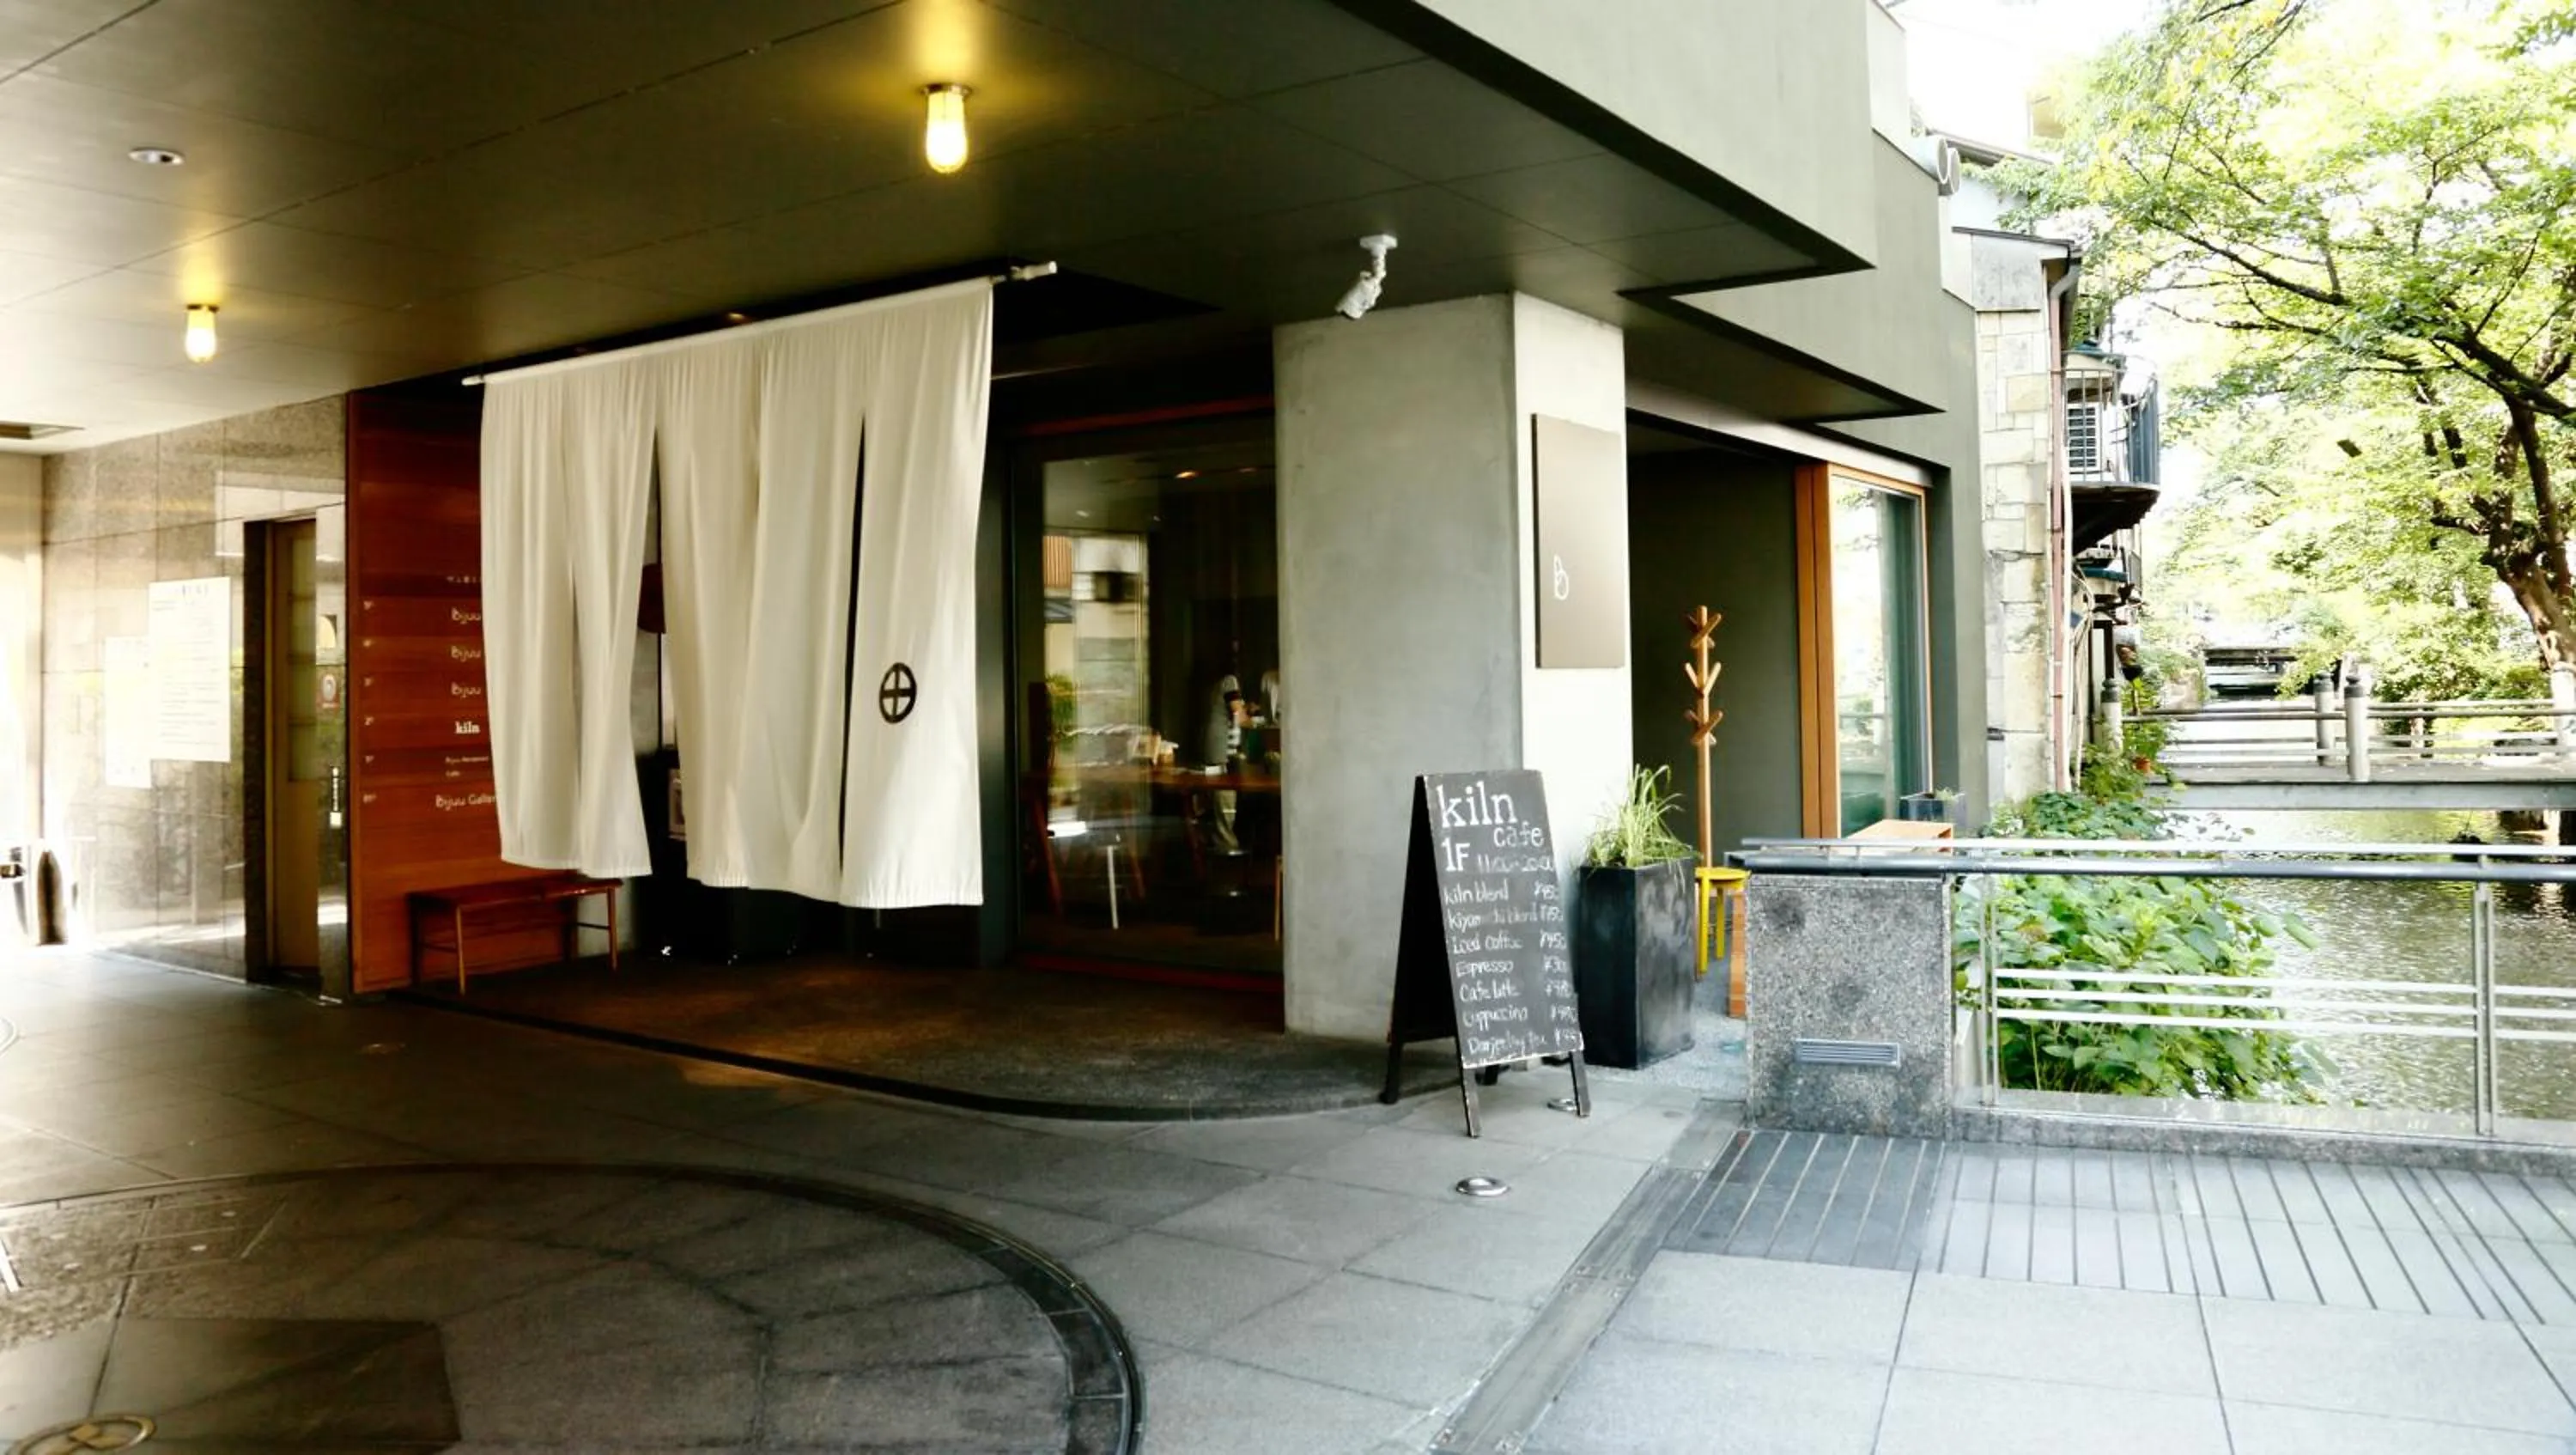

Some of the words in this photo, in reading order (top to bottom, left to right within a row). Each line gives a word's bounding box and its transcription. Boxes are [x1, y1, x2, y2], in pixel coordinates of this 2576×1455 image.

[454, 721, 481, 734] kiln
[1436, 780, 1518, 828] kiln
[1441, 836, 1471, 873] 1F
[1455, 960, 1514, 978] Espresso
